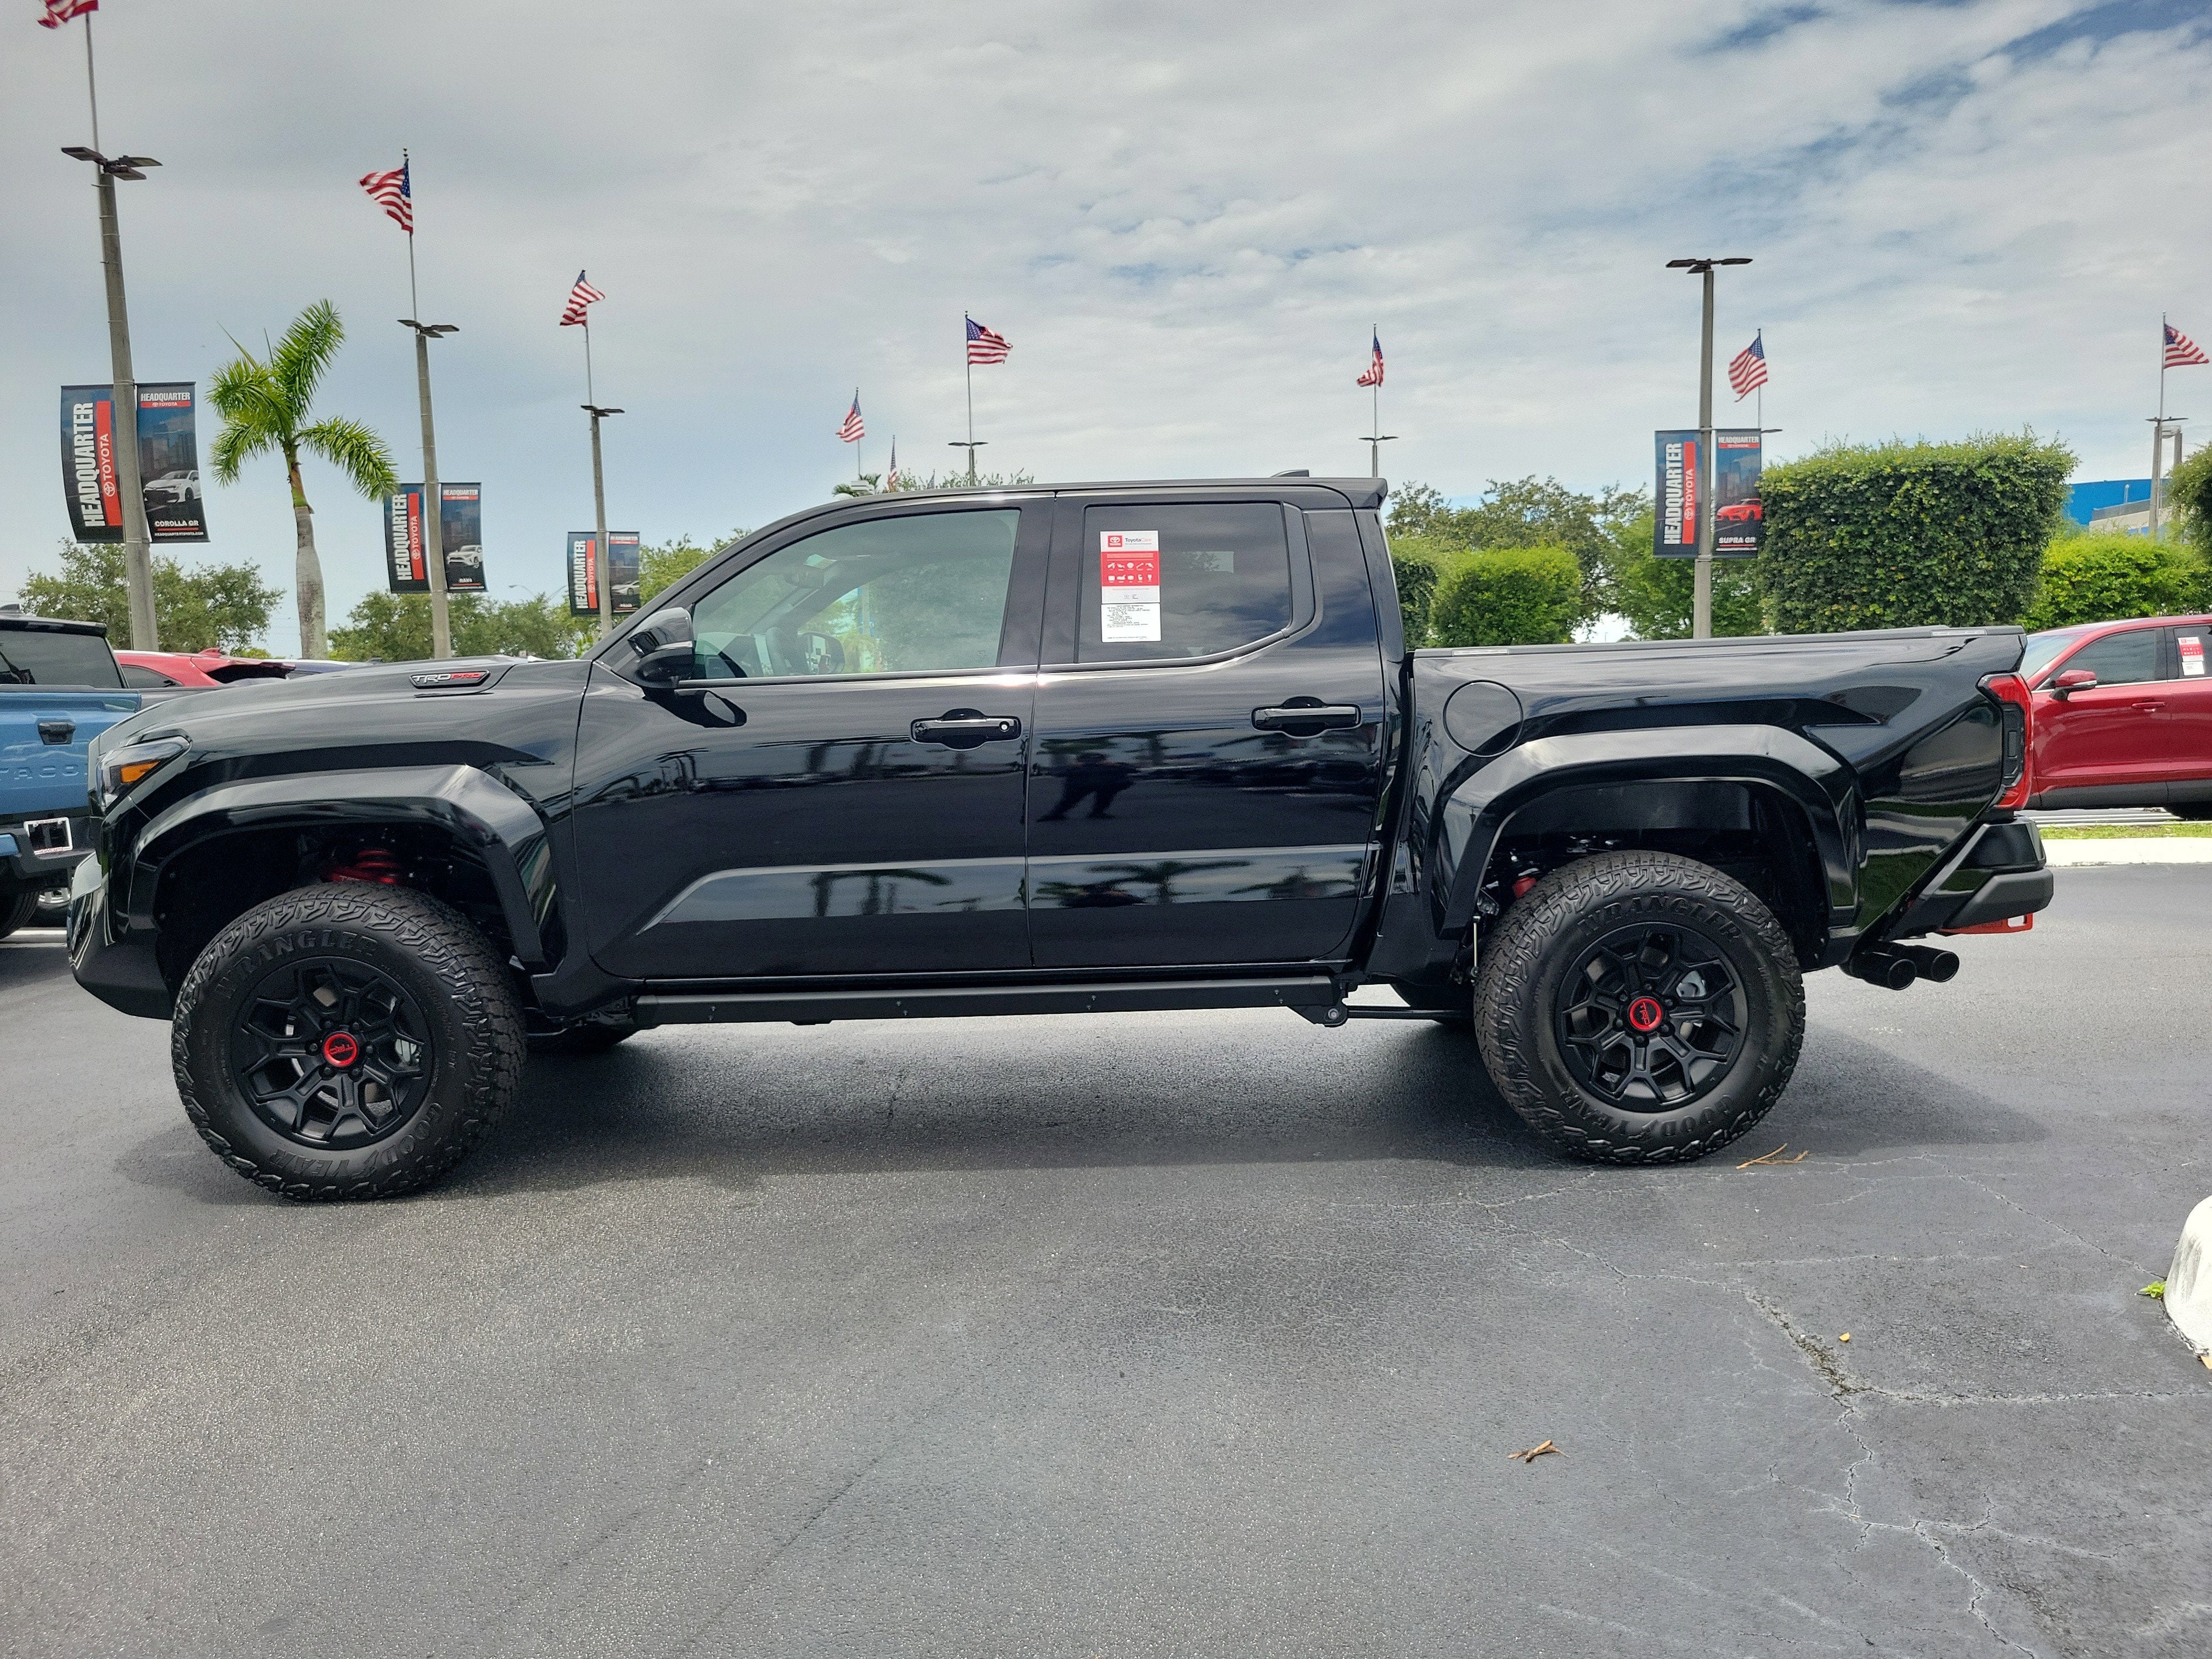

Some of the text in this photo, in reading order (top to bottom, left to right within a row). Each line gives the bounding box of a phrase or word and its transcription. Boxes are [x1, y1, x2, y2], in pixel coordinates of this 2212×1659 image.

[140, 392, 190, 402] HEADQUARTER
[73, 402, 106, 527] HEADQUARTER
[100, 433, 112, 479] TOYOTA
[1664, 443, 1683, 544] HEADQUARTER
[1685, 469, 1694, 507] TOYOTA
[392, 493, 413, 580] HEADQUARTER
[573, 540, 588, 608] HEADQUARTER
[412, 674, 451, 684] TRD
[1577, 894, 1742, 944] WRANGLER
[216, 929, 380, 1000] WRANGLER
[1639, 1002, 1650, 1025] TRD
